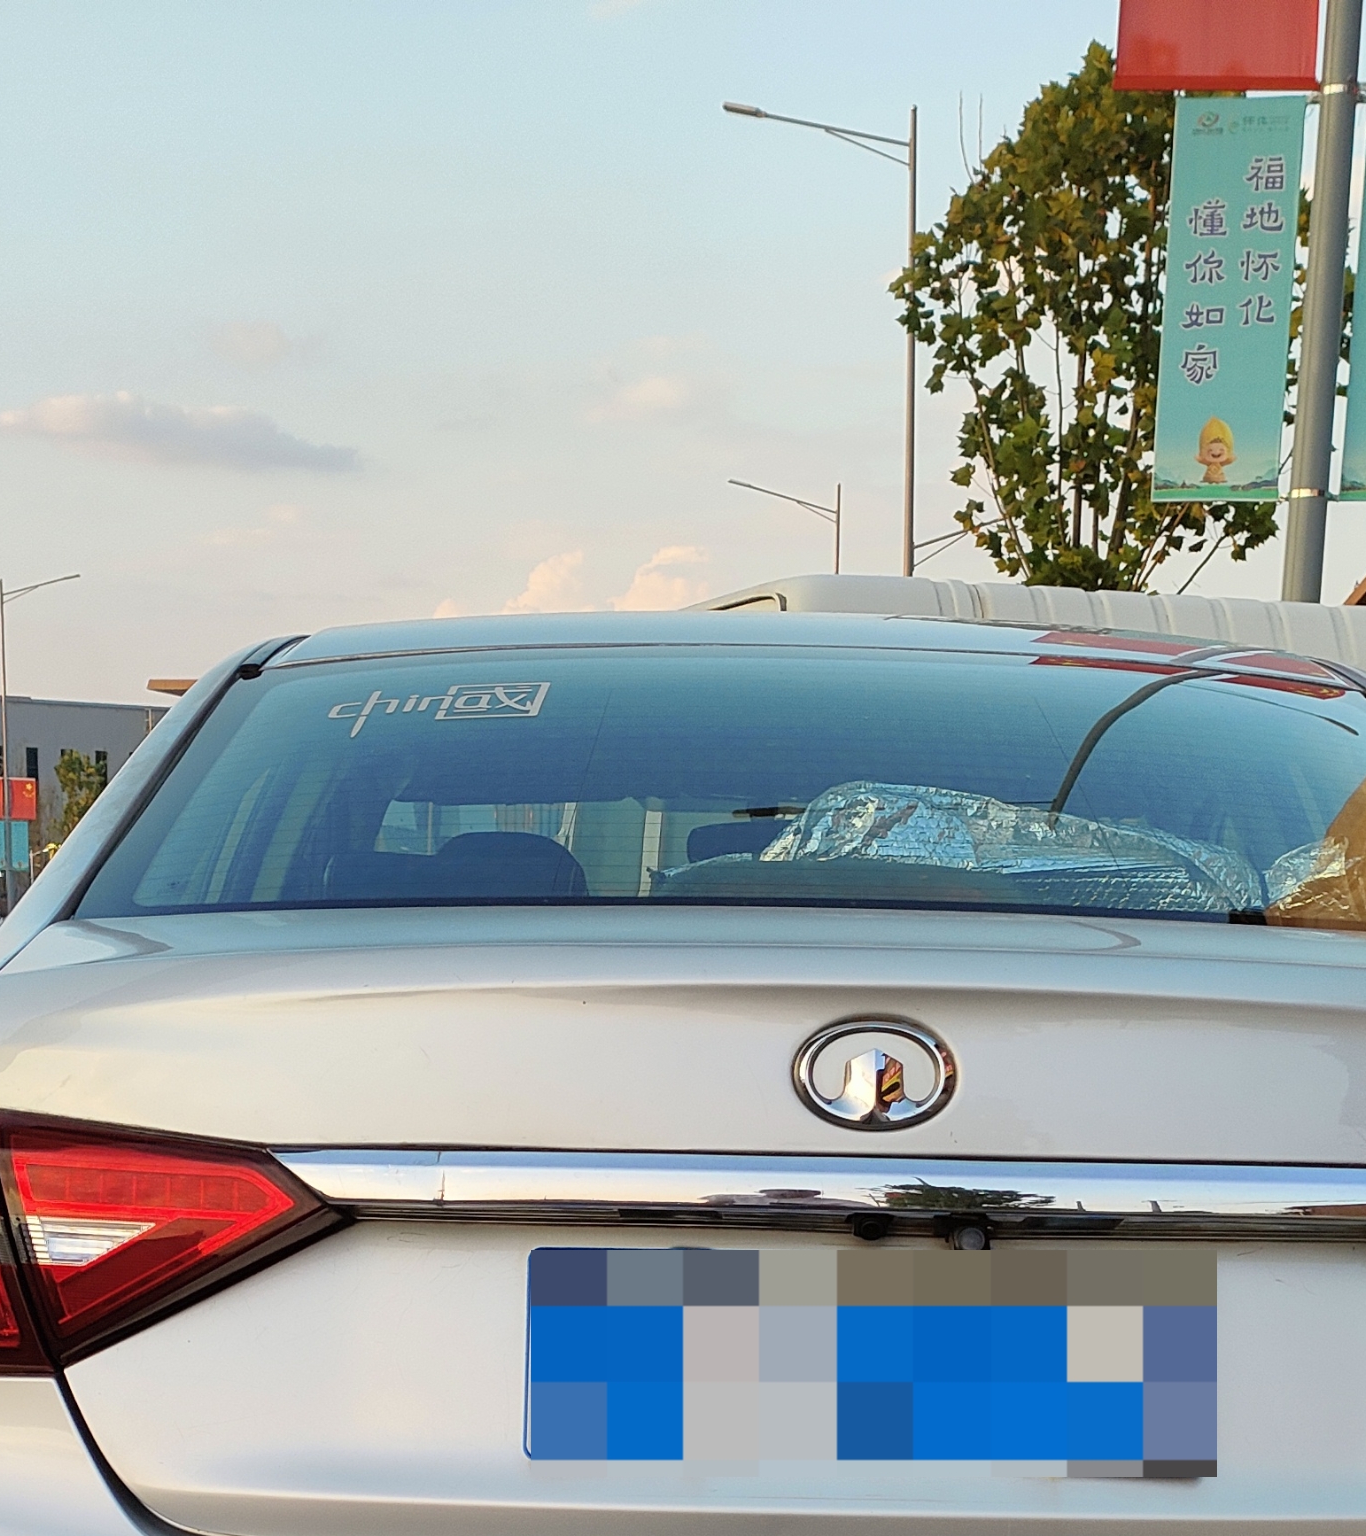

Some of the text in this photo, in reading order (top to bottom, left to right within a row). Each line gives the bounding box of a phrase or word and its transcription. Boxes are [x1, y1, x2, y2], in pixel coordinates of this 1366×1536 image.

[1181, 198, 1228, 385] 懂你如家
[1239, 155, 1286, 327] 福地怀化
